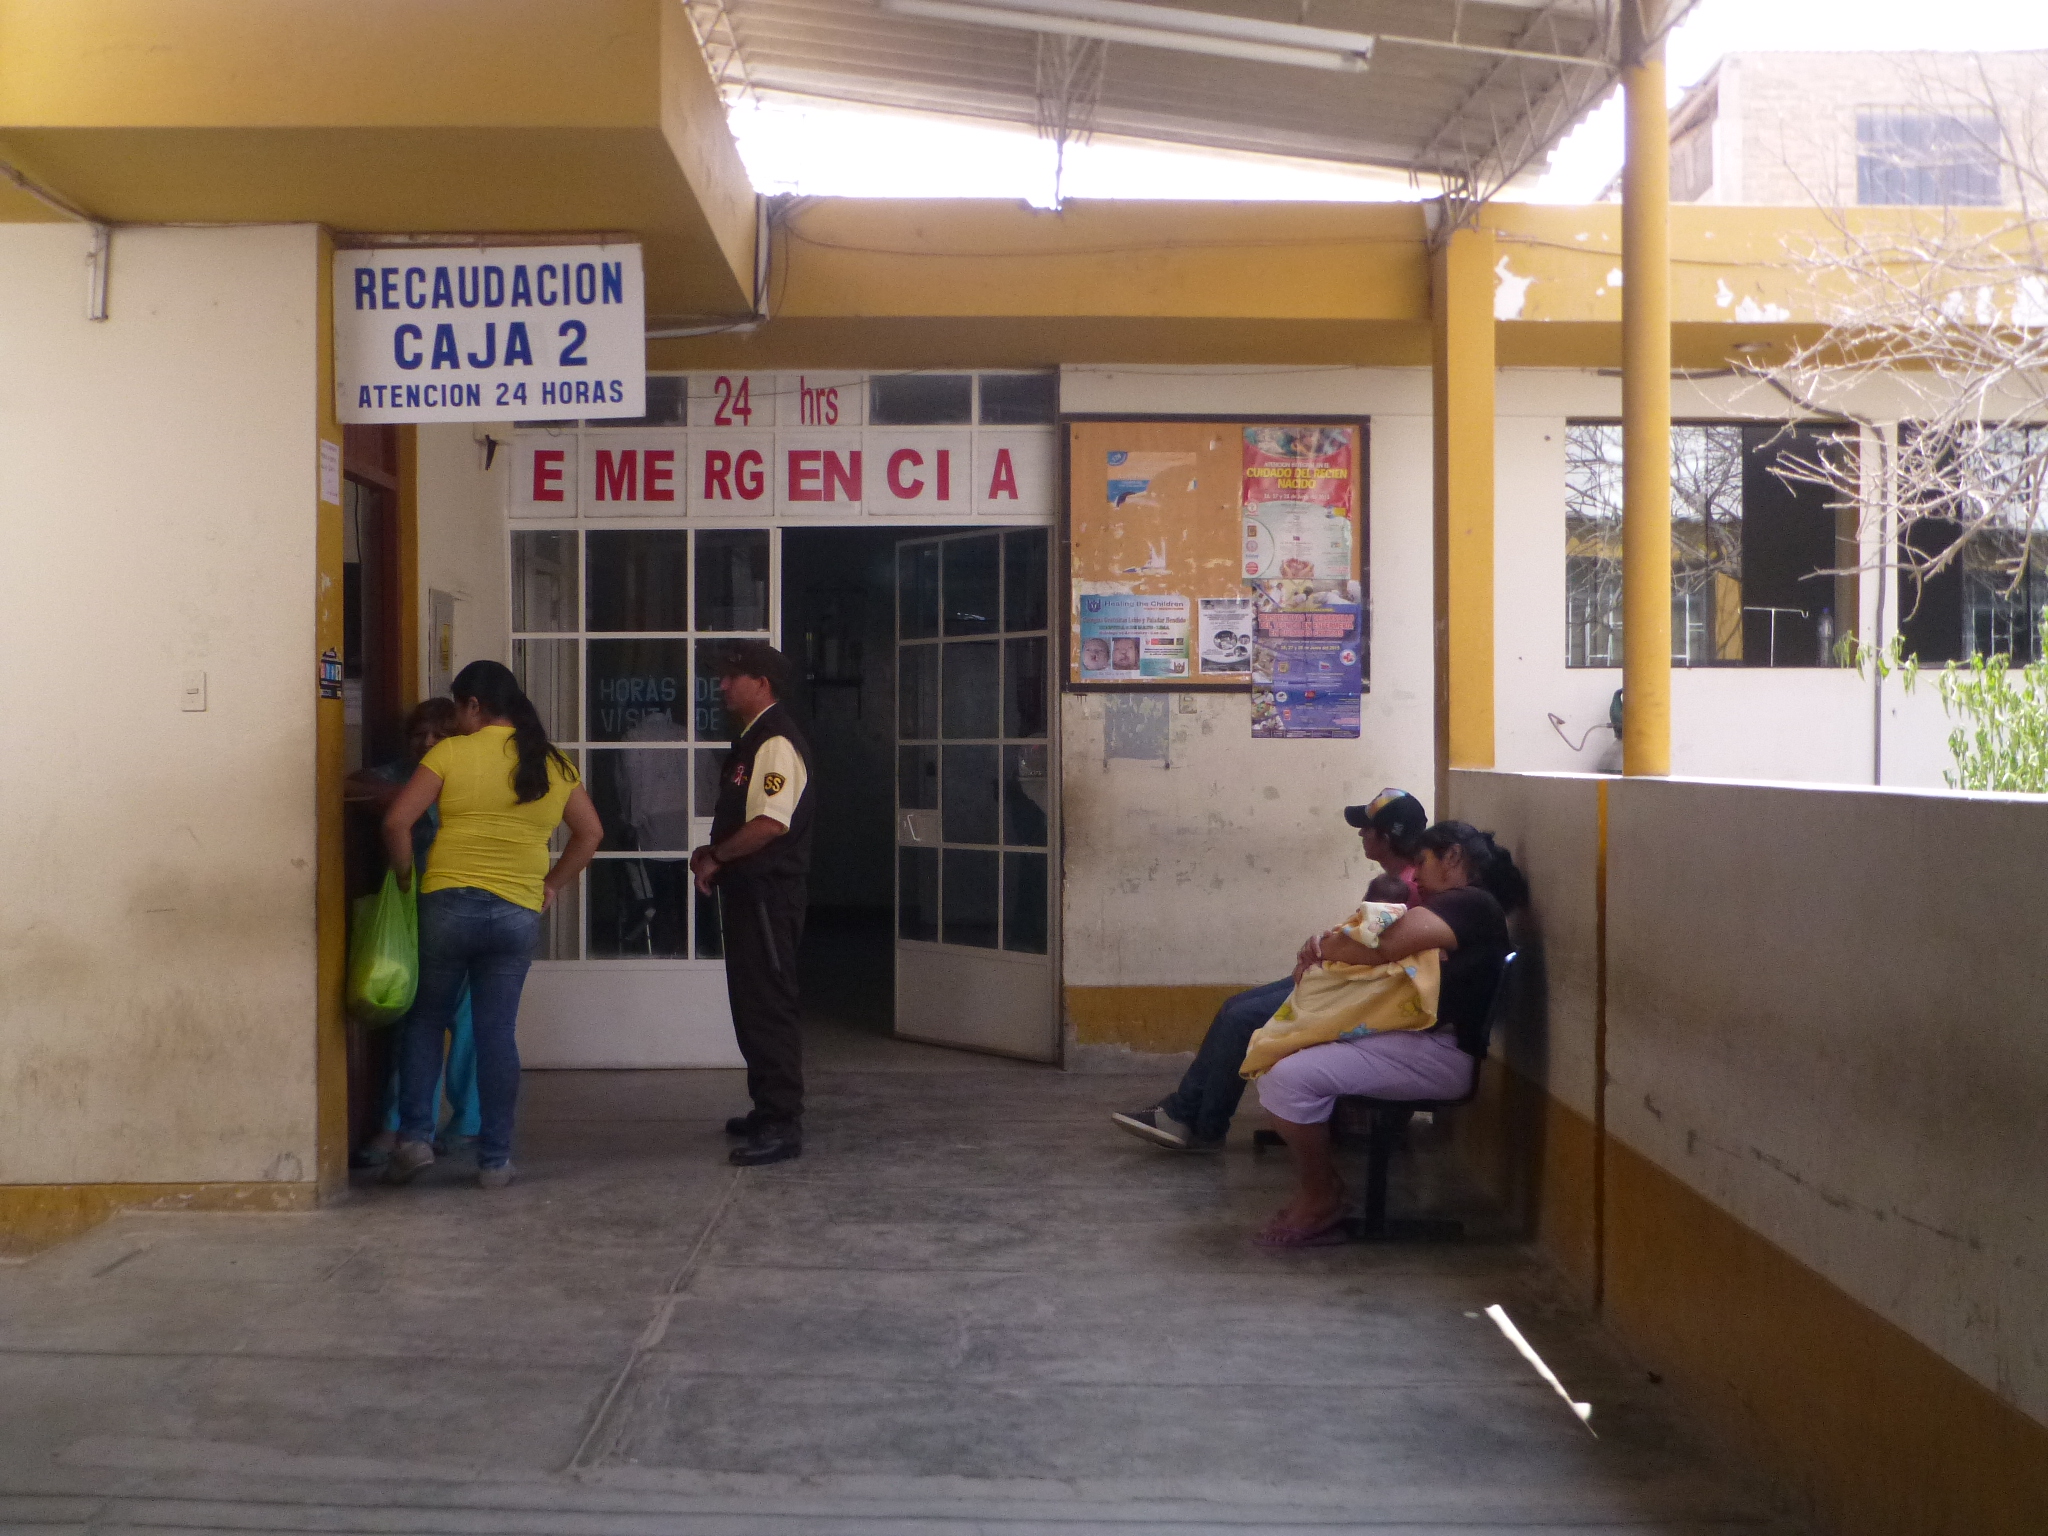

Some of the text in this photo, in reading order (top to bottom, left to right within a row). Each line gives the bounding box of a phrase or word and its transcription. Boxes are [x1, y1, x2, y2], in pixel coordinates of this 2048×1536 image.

[354, 261, 623, 310] RECAUDACION
[393, 319, 588, 370] CAJA 2
[358, 380, 623, 408] ATENCION 24 HORAS
[713, 376, 839, 426] 24 hrs
[1246, 467, 1348, 479] CUIDADO DEL RECIEN
[1278, 479, 1316, 488] NACIDO
[601, 676, 721, 702] HORAS DE
[695, 708, 719, 731] DE
[765, 775, 782, 792] SS
